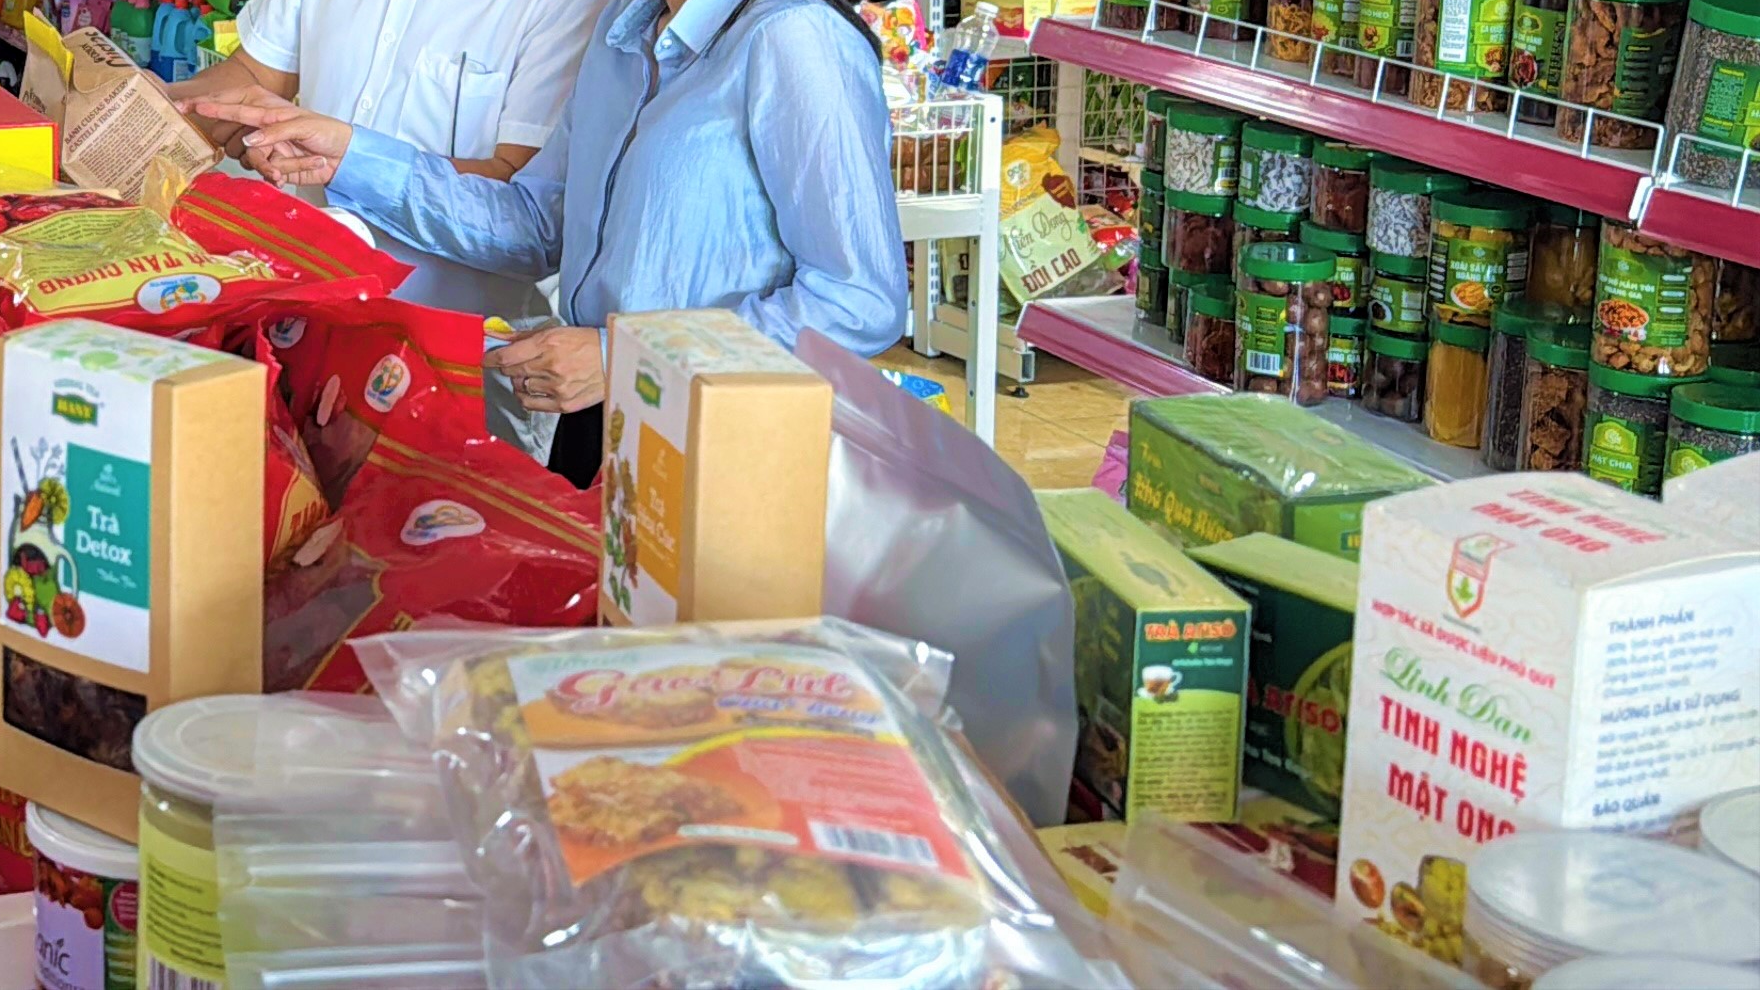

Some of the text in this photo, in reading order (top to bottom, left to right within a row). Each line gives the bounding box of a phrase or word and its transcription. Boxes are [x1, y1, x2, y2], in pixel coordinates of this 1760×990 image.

[68, 121, 102, 154] CASTELLA
[120, 87, 138, 105] LAVA
[81, 102, 106, 127] CUSTAS
[103, 78, 130, 105] BAKERY
[1020, 246, 1082, 294] ĐỒI CAO
[1609, 456, 1633, 471] CHIA
[87, 504, 120, 537] Trà
[75, 529, 133, 567] Detox
[1143, 618, 1180, 642] TRÀ
[1608, 607, 1695, 634] THÀNH PHẦN
[1600, 704, 1651, 726] HƯỚNG
[1653, 696, 1682, 717] DẪN
[1703, 687, 1741, 709] DỤNG
[1379, 693, 1441, 757] TINH
[1449, 727, 1528, 806] NGHỆ
[1387, 761, 1449, 824] MẬT
[1592, 790, 1662, 818] BẢO QUẢN
